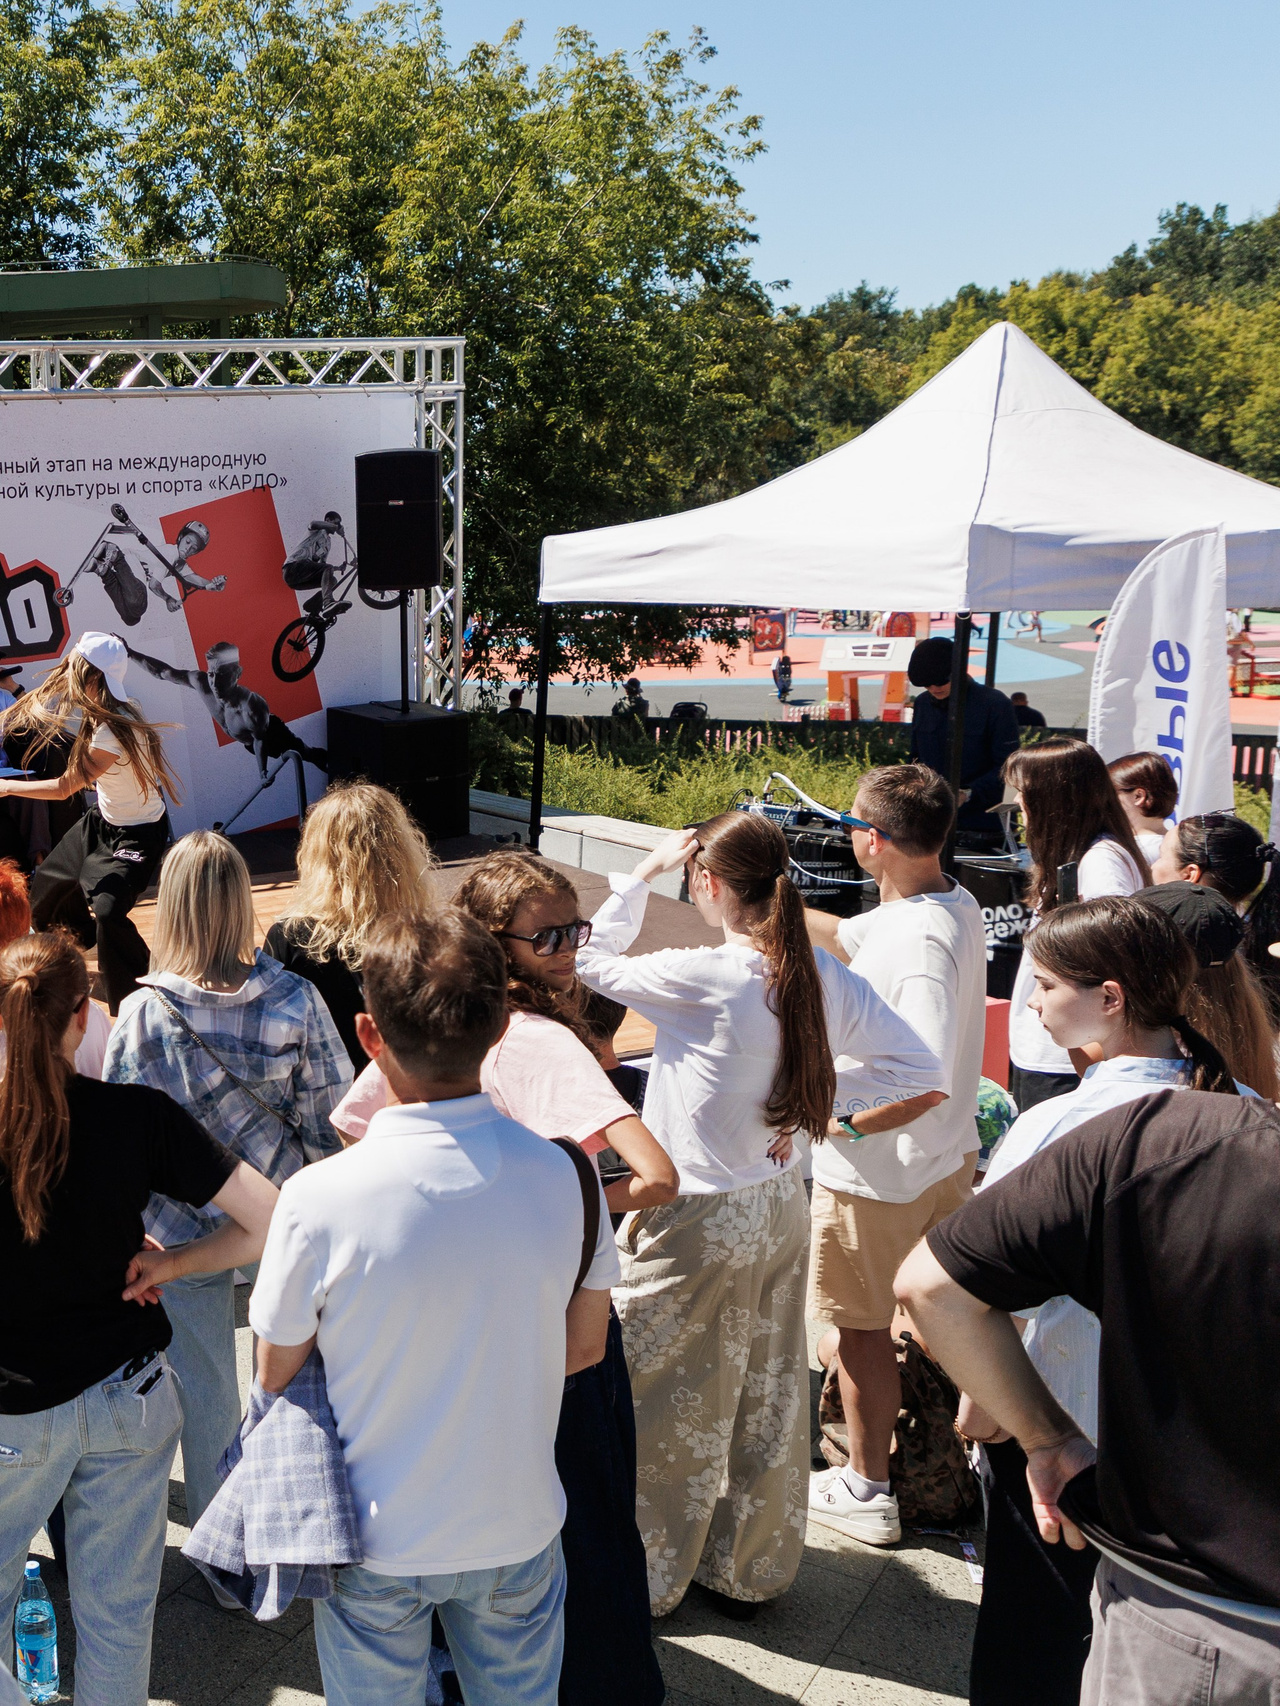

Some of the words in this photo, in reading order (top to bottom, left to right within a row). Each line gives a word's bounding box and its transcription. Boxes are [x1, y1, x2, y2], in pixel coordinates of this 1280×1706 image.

[46, 459, 86, 474] этап
[92, 458, 113, 471] на
[119, 452, 267, 472] международную
[35, 481, 120, 501] культуры
[126, 481, 136, 494] и
[142, 478, 203, 497] спорта
[208, 472, 288, 493] «КАРДО»
